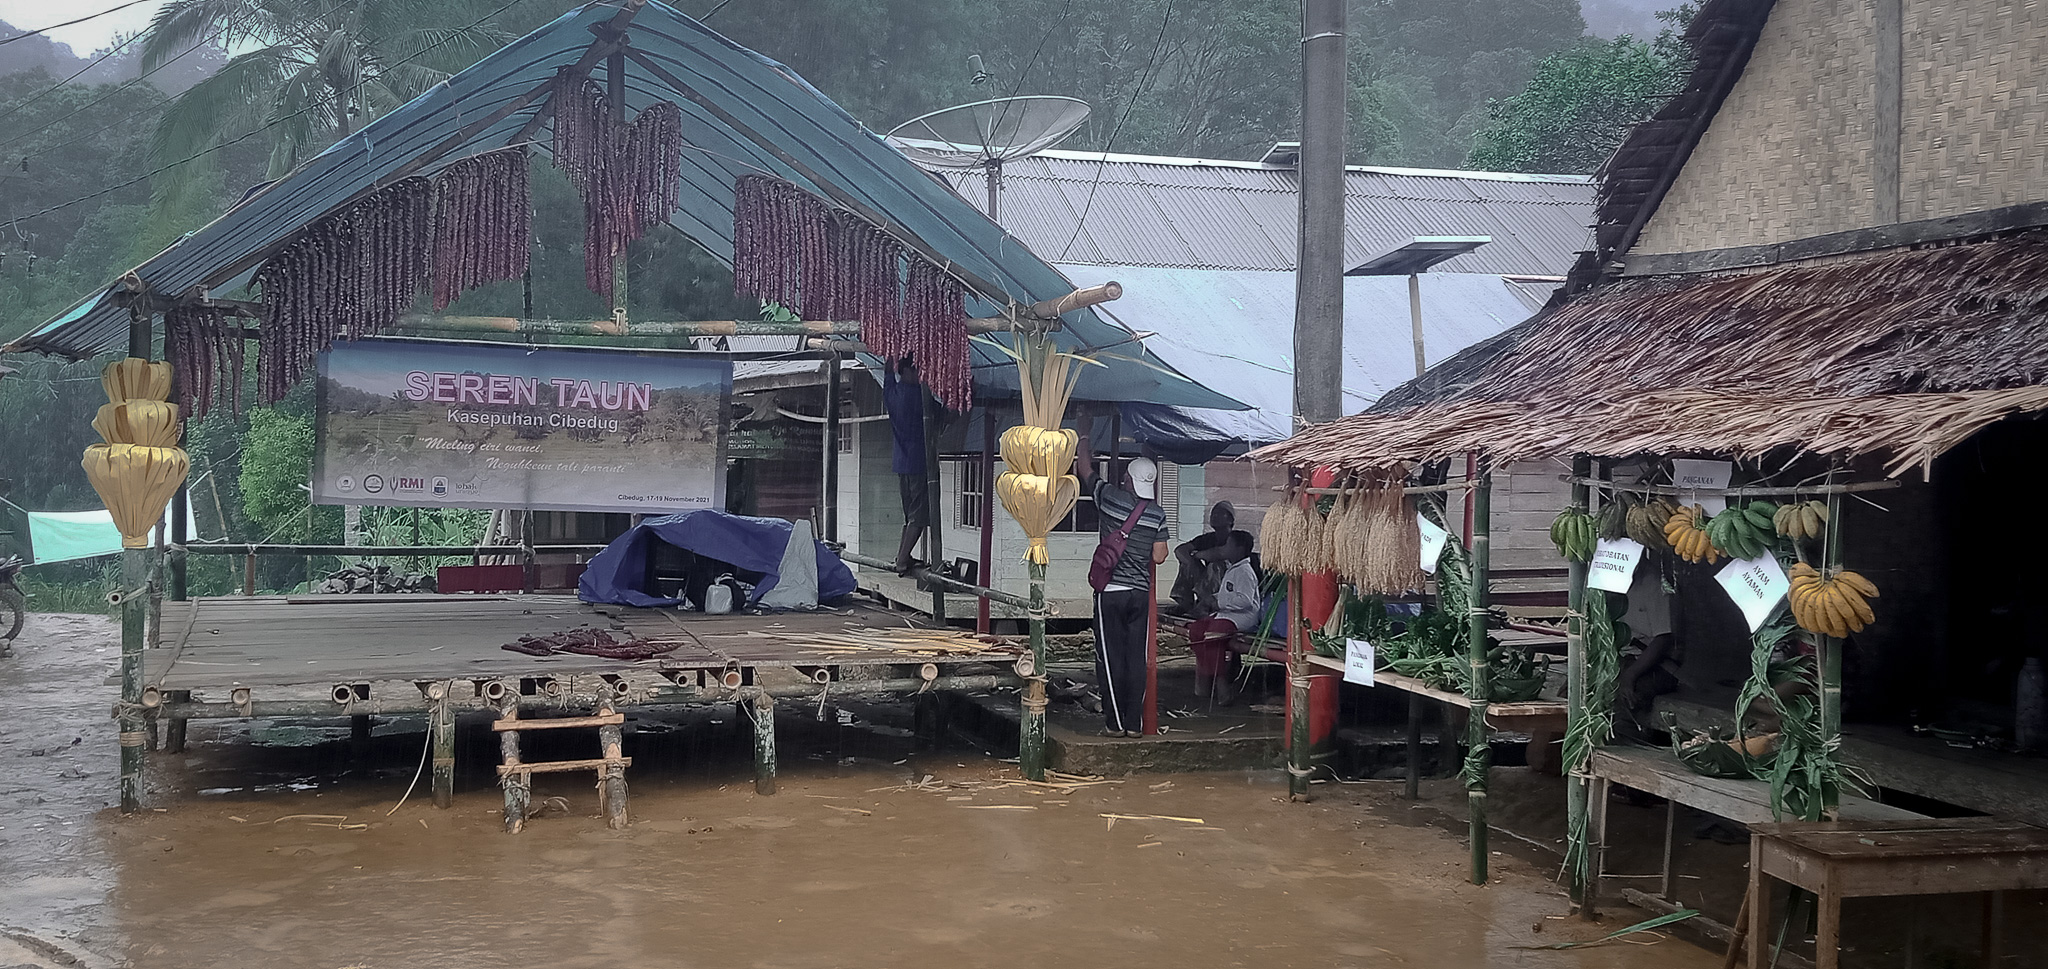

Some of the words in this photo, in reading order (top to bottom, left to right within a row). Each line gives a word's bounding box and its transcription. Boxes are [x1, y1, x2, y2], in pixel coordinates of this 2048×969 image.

[406, 371, 537, 406] SEREN
[551, 377, 652, 411] TAUN
[447, 410, 543, 427] Kasepuhan
[549, 414, 618, 432] Cibedug
[400, 478, 424, 489] RMI
[1752, 565, 1770, 586] AYAM
